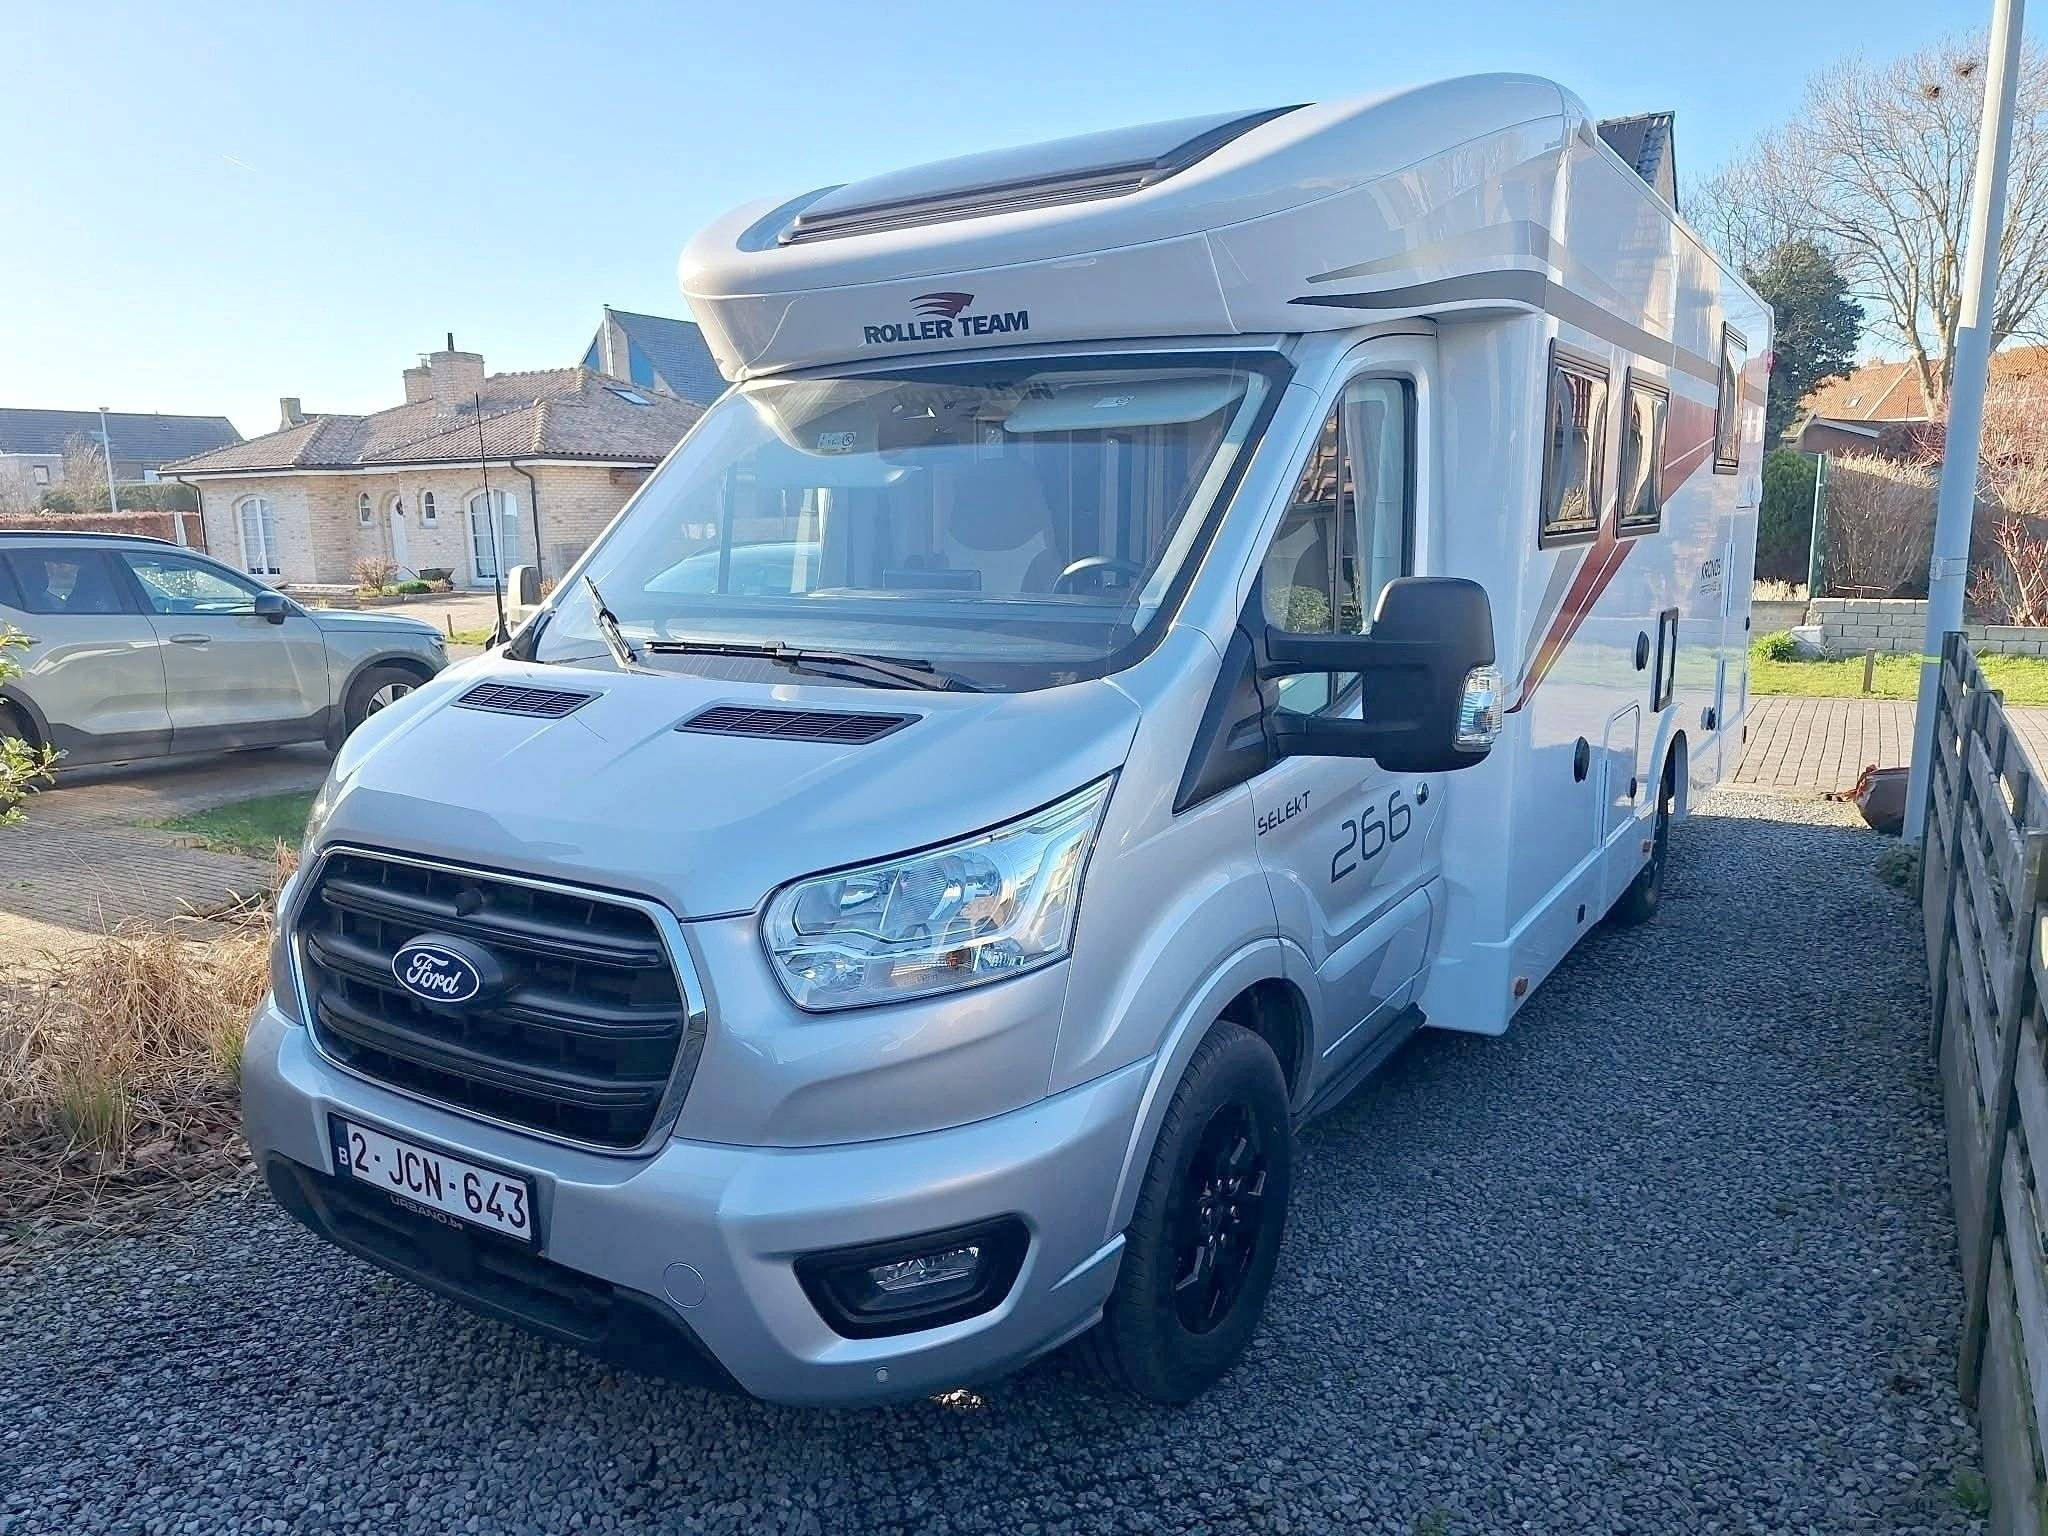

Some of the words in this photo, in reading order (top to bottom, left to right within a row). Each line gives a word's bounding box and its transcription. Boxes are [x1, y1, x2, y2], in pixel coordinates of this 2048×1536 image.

[863, 320, 954, 345] ROLLER
[958, 310, 1030, 337] TEAM
[1331, 789, 1411, 884] 266
[406, 952, 462, 995] Ford
[338, 1147, 349, 1166] B
[351, 1132, 526, 1229] 2-JCN-643
